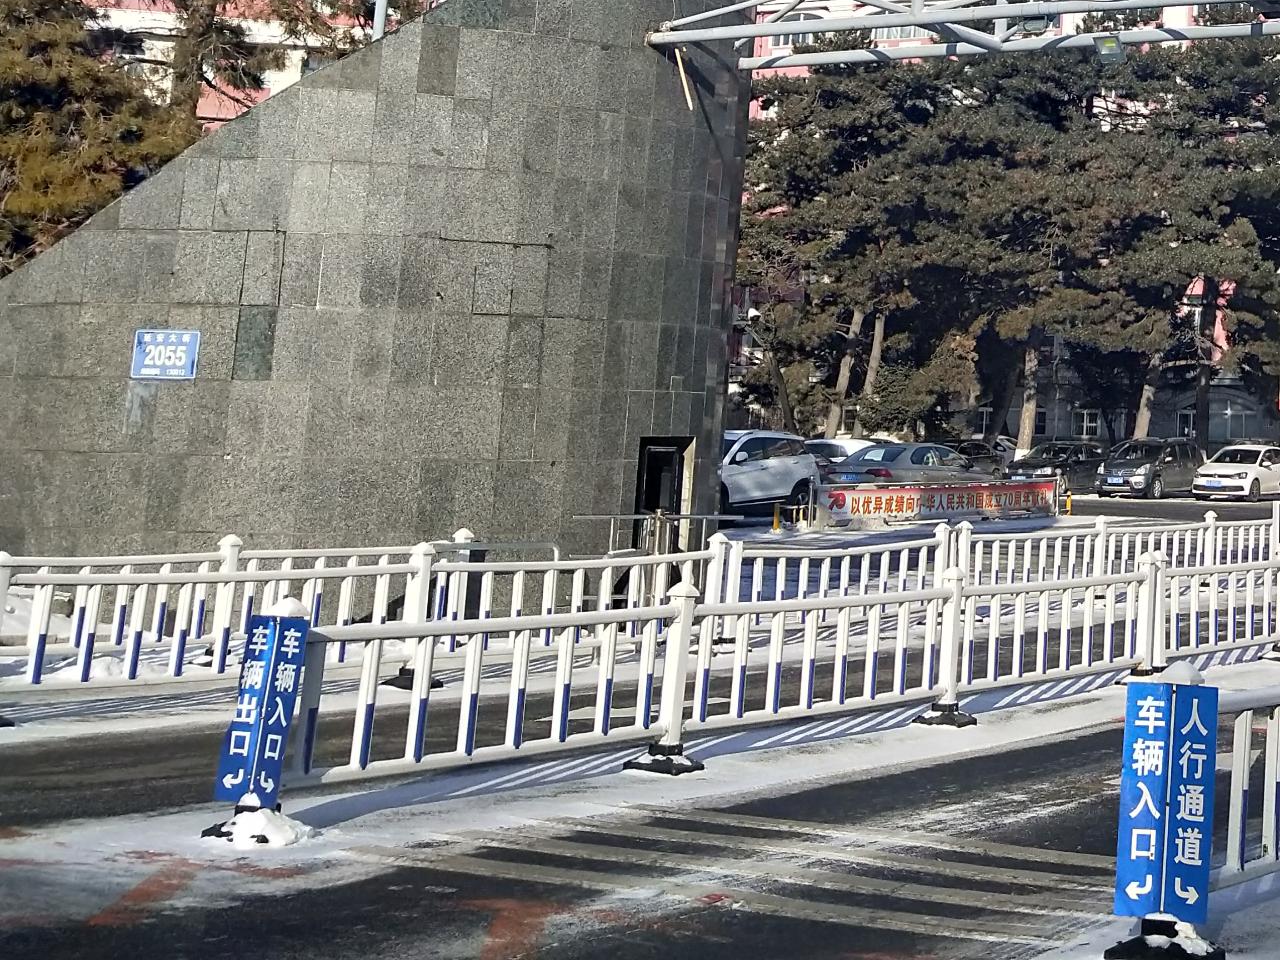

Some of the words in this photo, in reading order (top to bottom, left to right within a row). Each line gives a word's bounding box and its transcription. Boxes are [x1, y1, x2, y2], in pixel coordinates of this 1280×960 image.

[143, 345, 187, 366] 2055
[229, 625, 270, 757] 车辆出口
[263, 628, 302, 761] 车辆入口
[1129, 696, 1166, 861] 车辆入口
[1174, 698, 1208, 866] 人行通道
